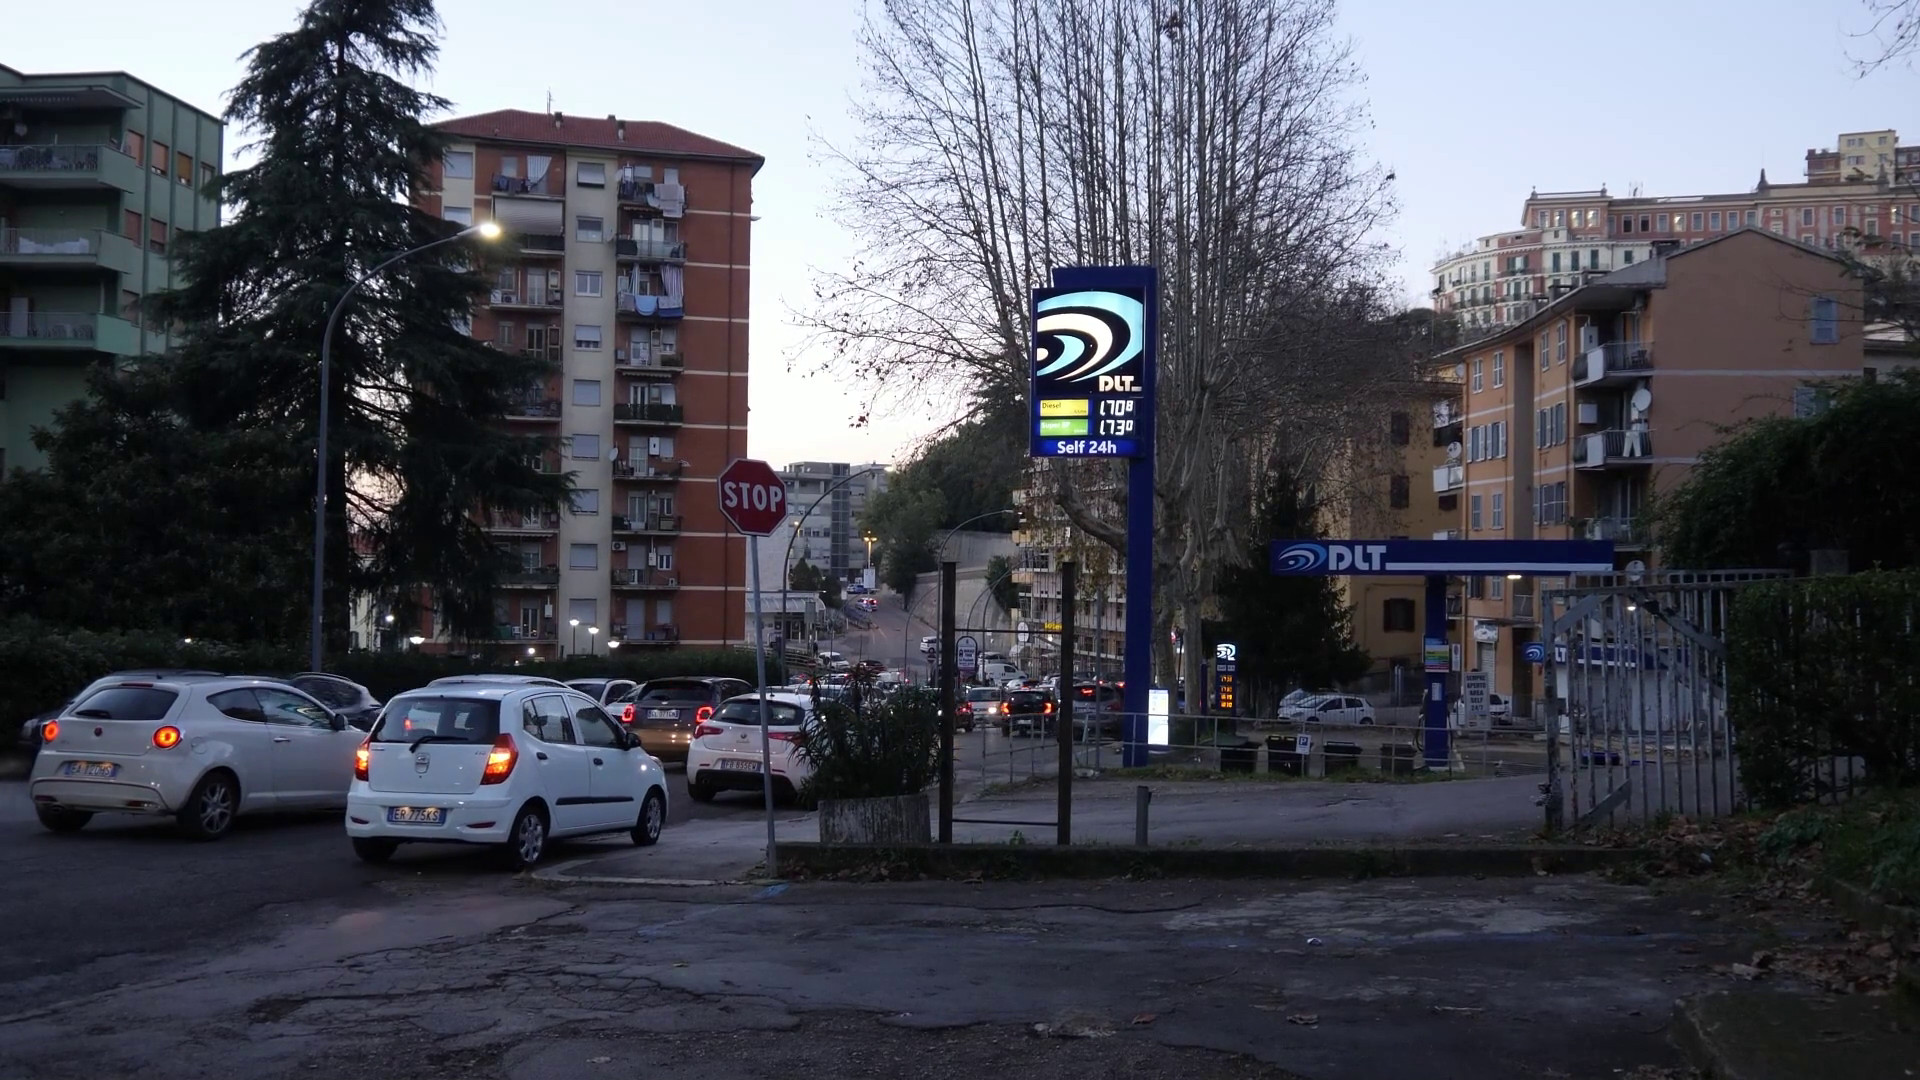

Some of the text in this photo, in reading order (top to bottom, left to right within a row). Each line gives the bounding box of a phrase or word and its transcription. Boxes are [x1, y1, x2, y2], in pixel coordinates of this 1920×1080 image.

[1098, 375, 1134, 392] DLT
[1057, 441, 1117, 454] Self 24h
[723, 481, 783, 513] STOP
[1328, 545, 1387, 571] DLT
[395, 808, 439, 821] ER 775KS
